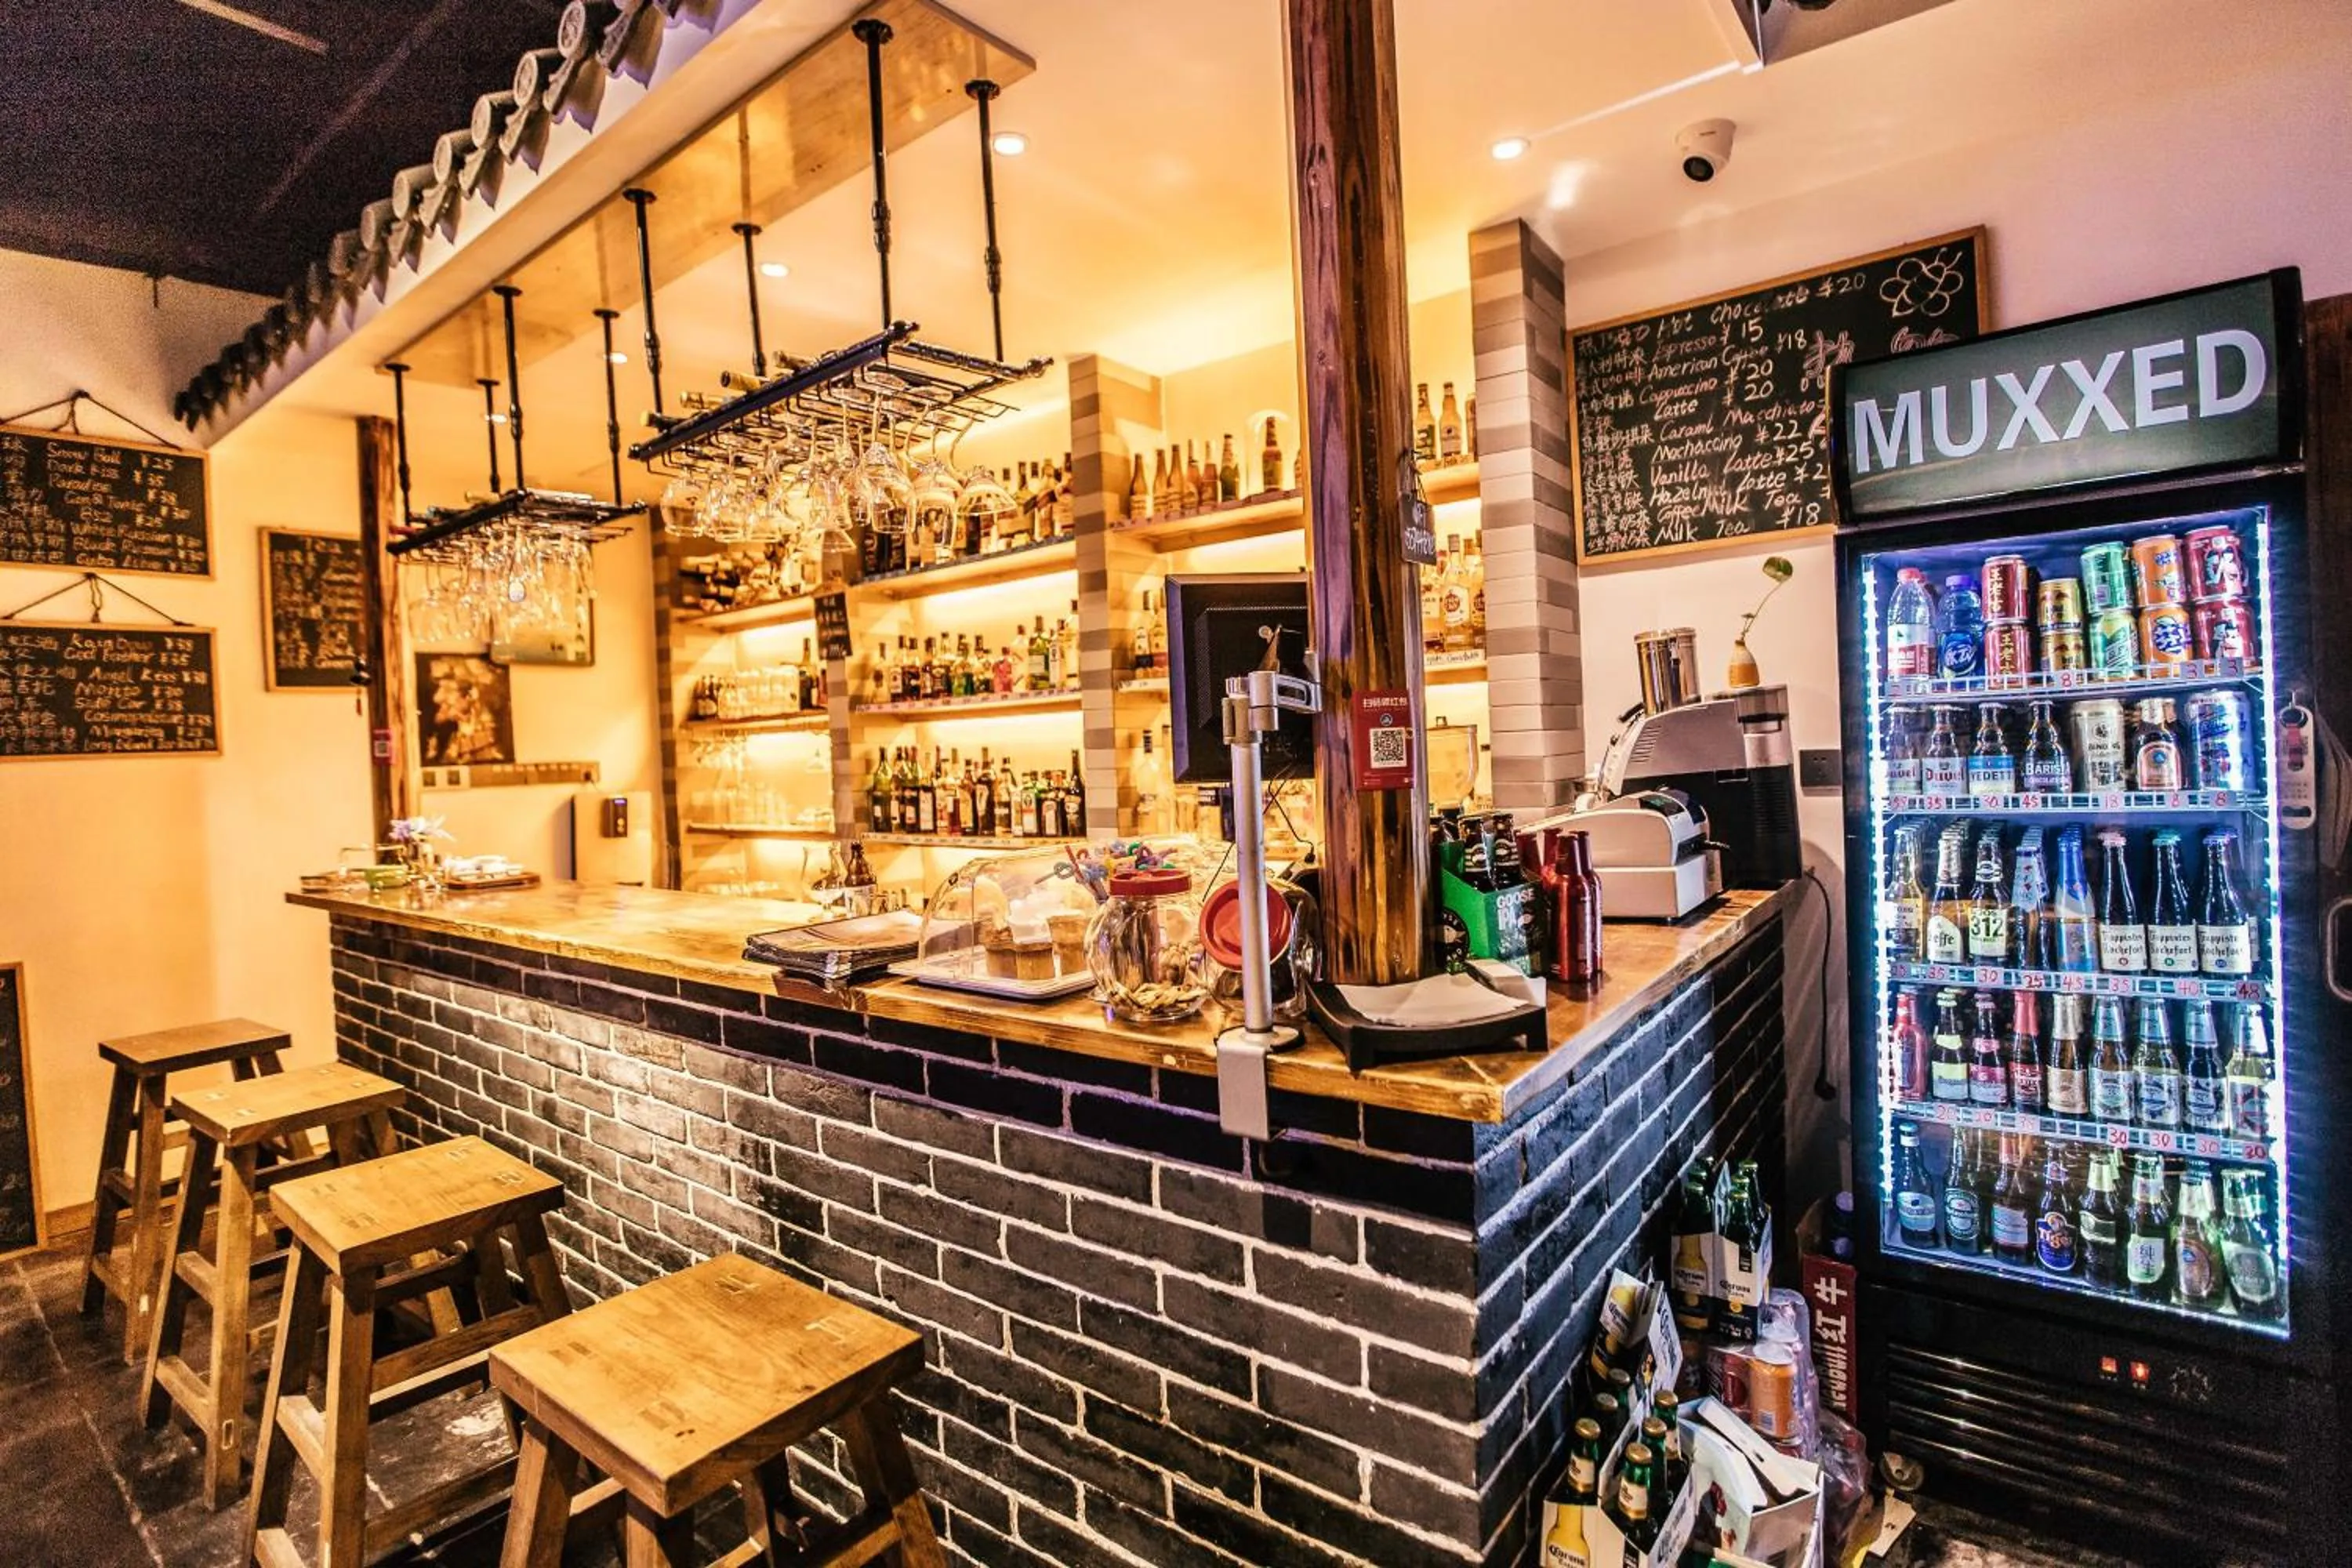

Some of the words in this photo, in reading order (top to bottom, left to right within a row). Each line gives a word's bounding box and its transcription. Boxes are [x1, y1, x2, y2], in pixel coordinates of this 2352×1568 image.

[1657, 312, 1693, 339] Hot
[1647, 358, 1718, 382] American
[1654, 399, 1699, 421] Latte
[1853, 329, 2267, 474] MUXXED
[1650, 459, 1710, 487] Vanilla
[1723, 449, 1773, 474] Latte
[1737, 471, 1787, 492] Latte
[1765, 488, 1802, 510] Tea
[1654, 523, 1698, 546] Milk
[1716, 519, 1751, 539] Tea
[2061, 673, 2071, 687] 8
[1969, 771, 2012, 782] VEDETT
[1927, 796, 1942, 810] 35
[2022, 794, 2038, 808] 45
[2214, 791, 2227, 806] 8
[1496, 888, 1534, 909] GOOSE
[1971, 917, 2004, 937] 312
[1979, 968, 1998, 982] 30
[2023, 975, 2042, 989] 25
[2063, 975, 2083, 991] 45
[2112, 978, 2129, 993] 35
[2239, 982, 2259, 1000] 48
[2109, 1127, 2127, 1144] 30
[2152, 1132, 2171, 1147] 30
[2198, 1138, 2220, 1153] 30
[1719, 1279, 1751, 1294] Corona
[1813, 1276, 1848, 1344] 红牛
[1548, 1544, 1586, 1566] Corona
